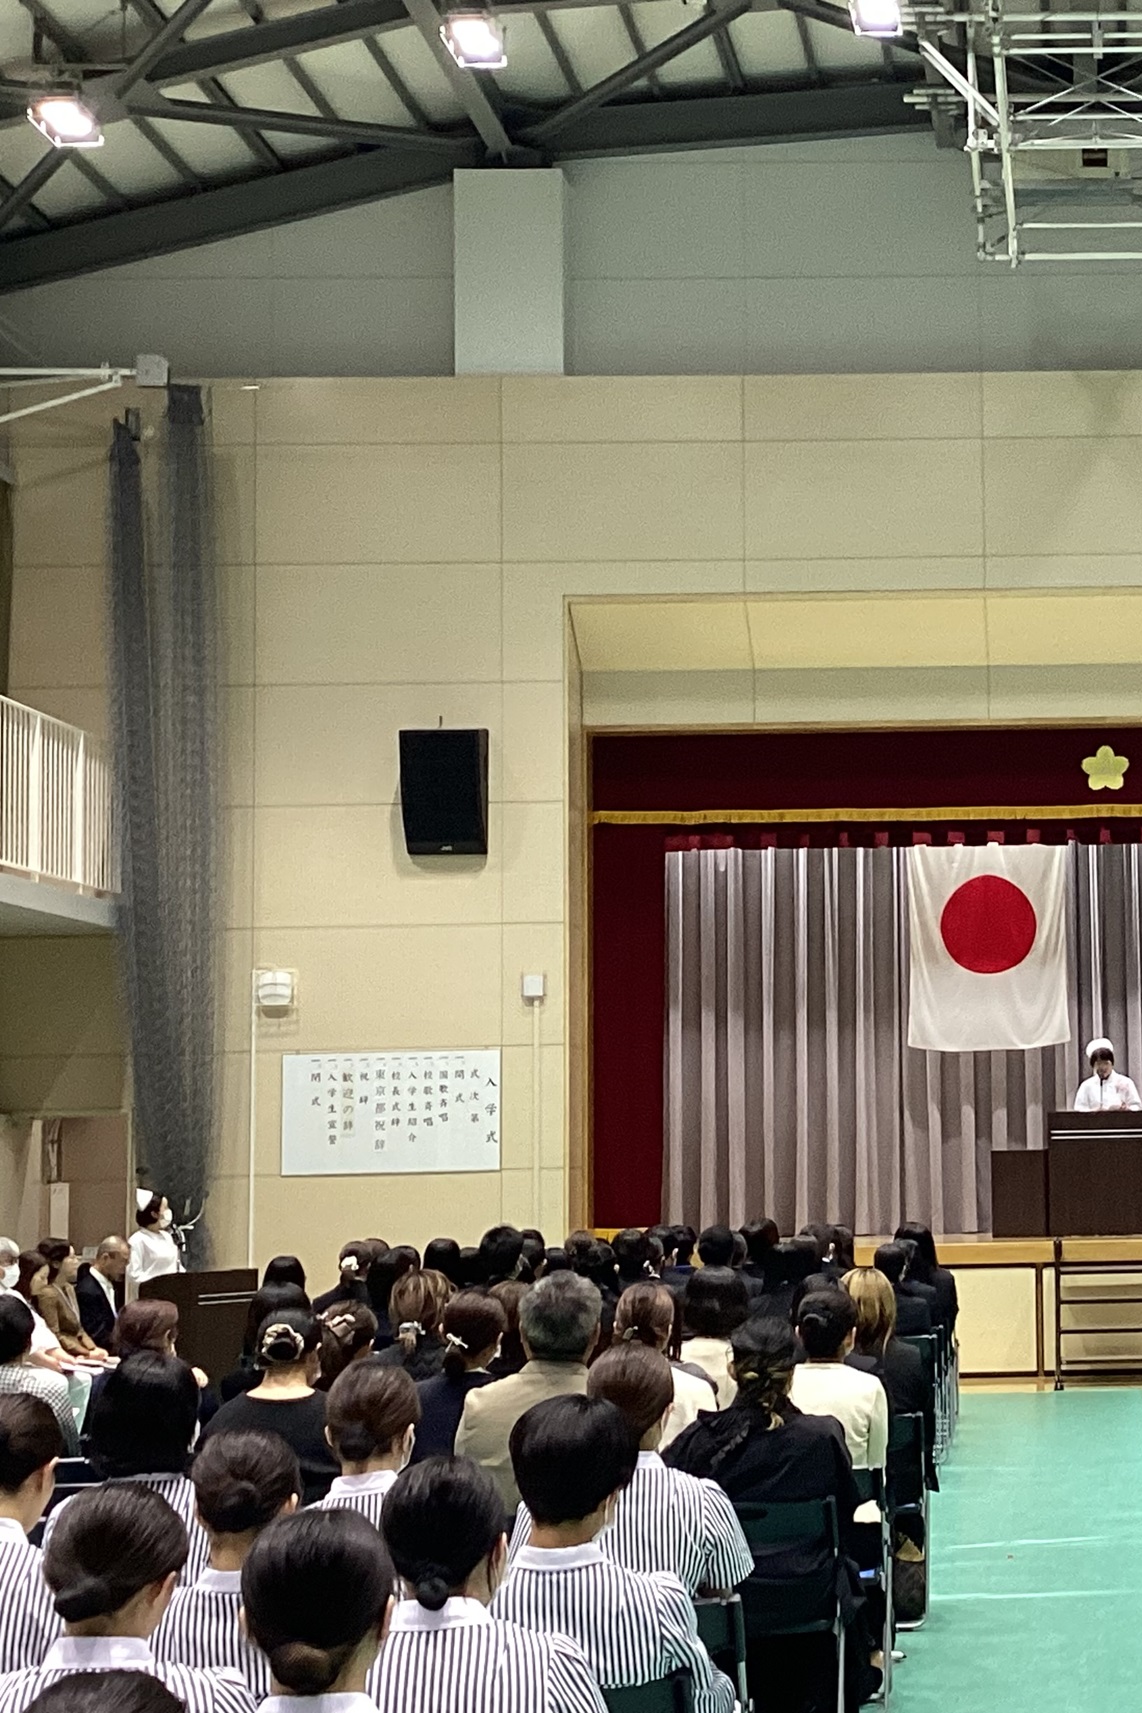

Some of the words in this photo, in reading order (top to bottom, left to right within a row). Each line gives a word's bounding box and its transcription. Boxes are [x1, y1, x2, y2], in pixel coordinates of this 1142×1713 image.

[469, 1069, 480, 1123] 式次第
[485, 1077, 498, 1143] 入学式
